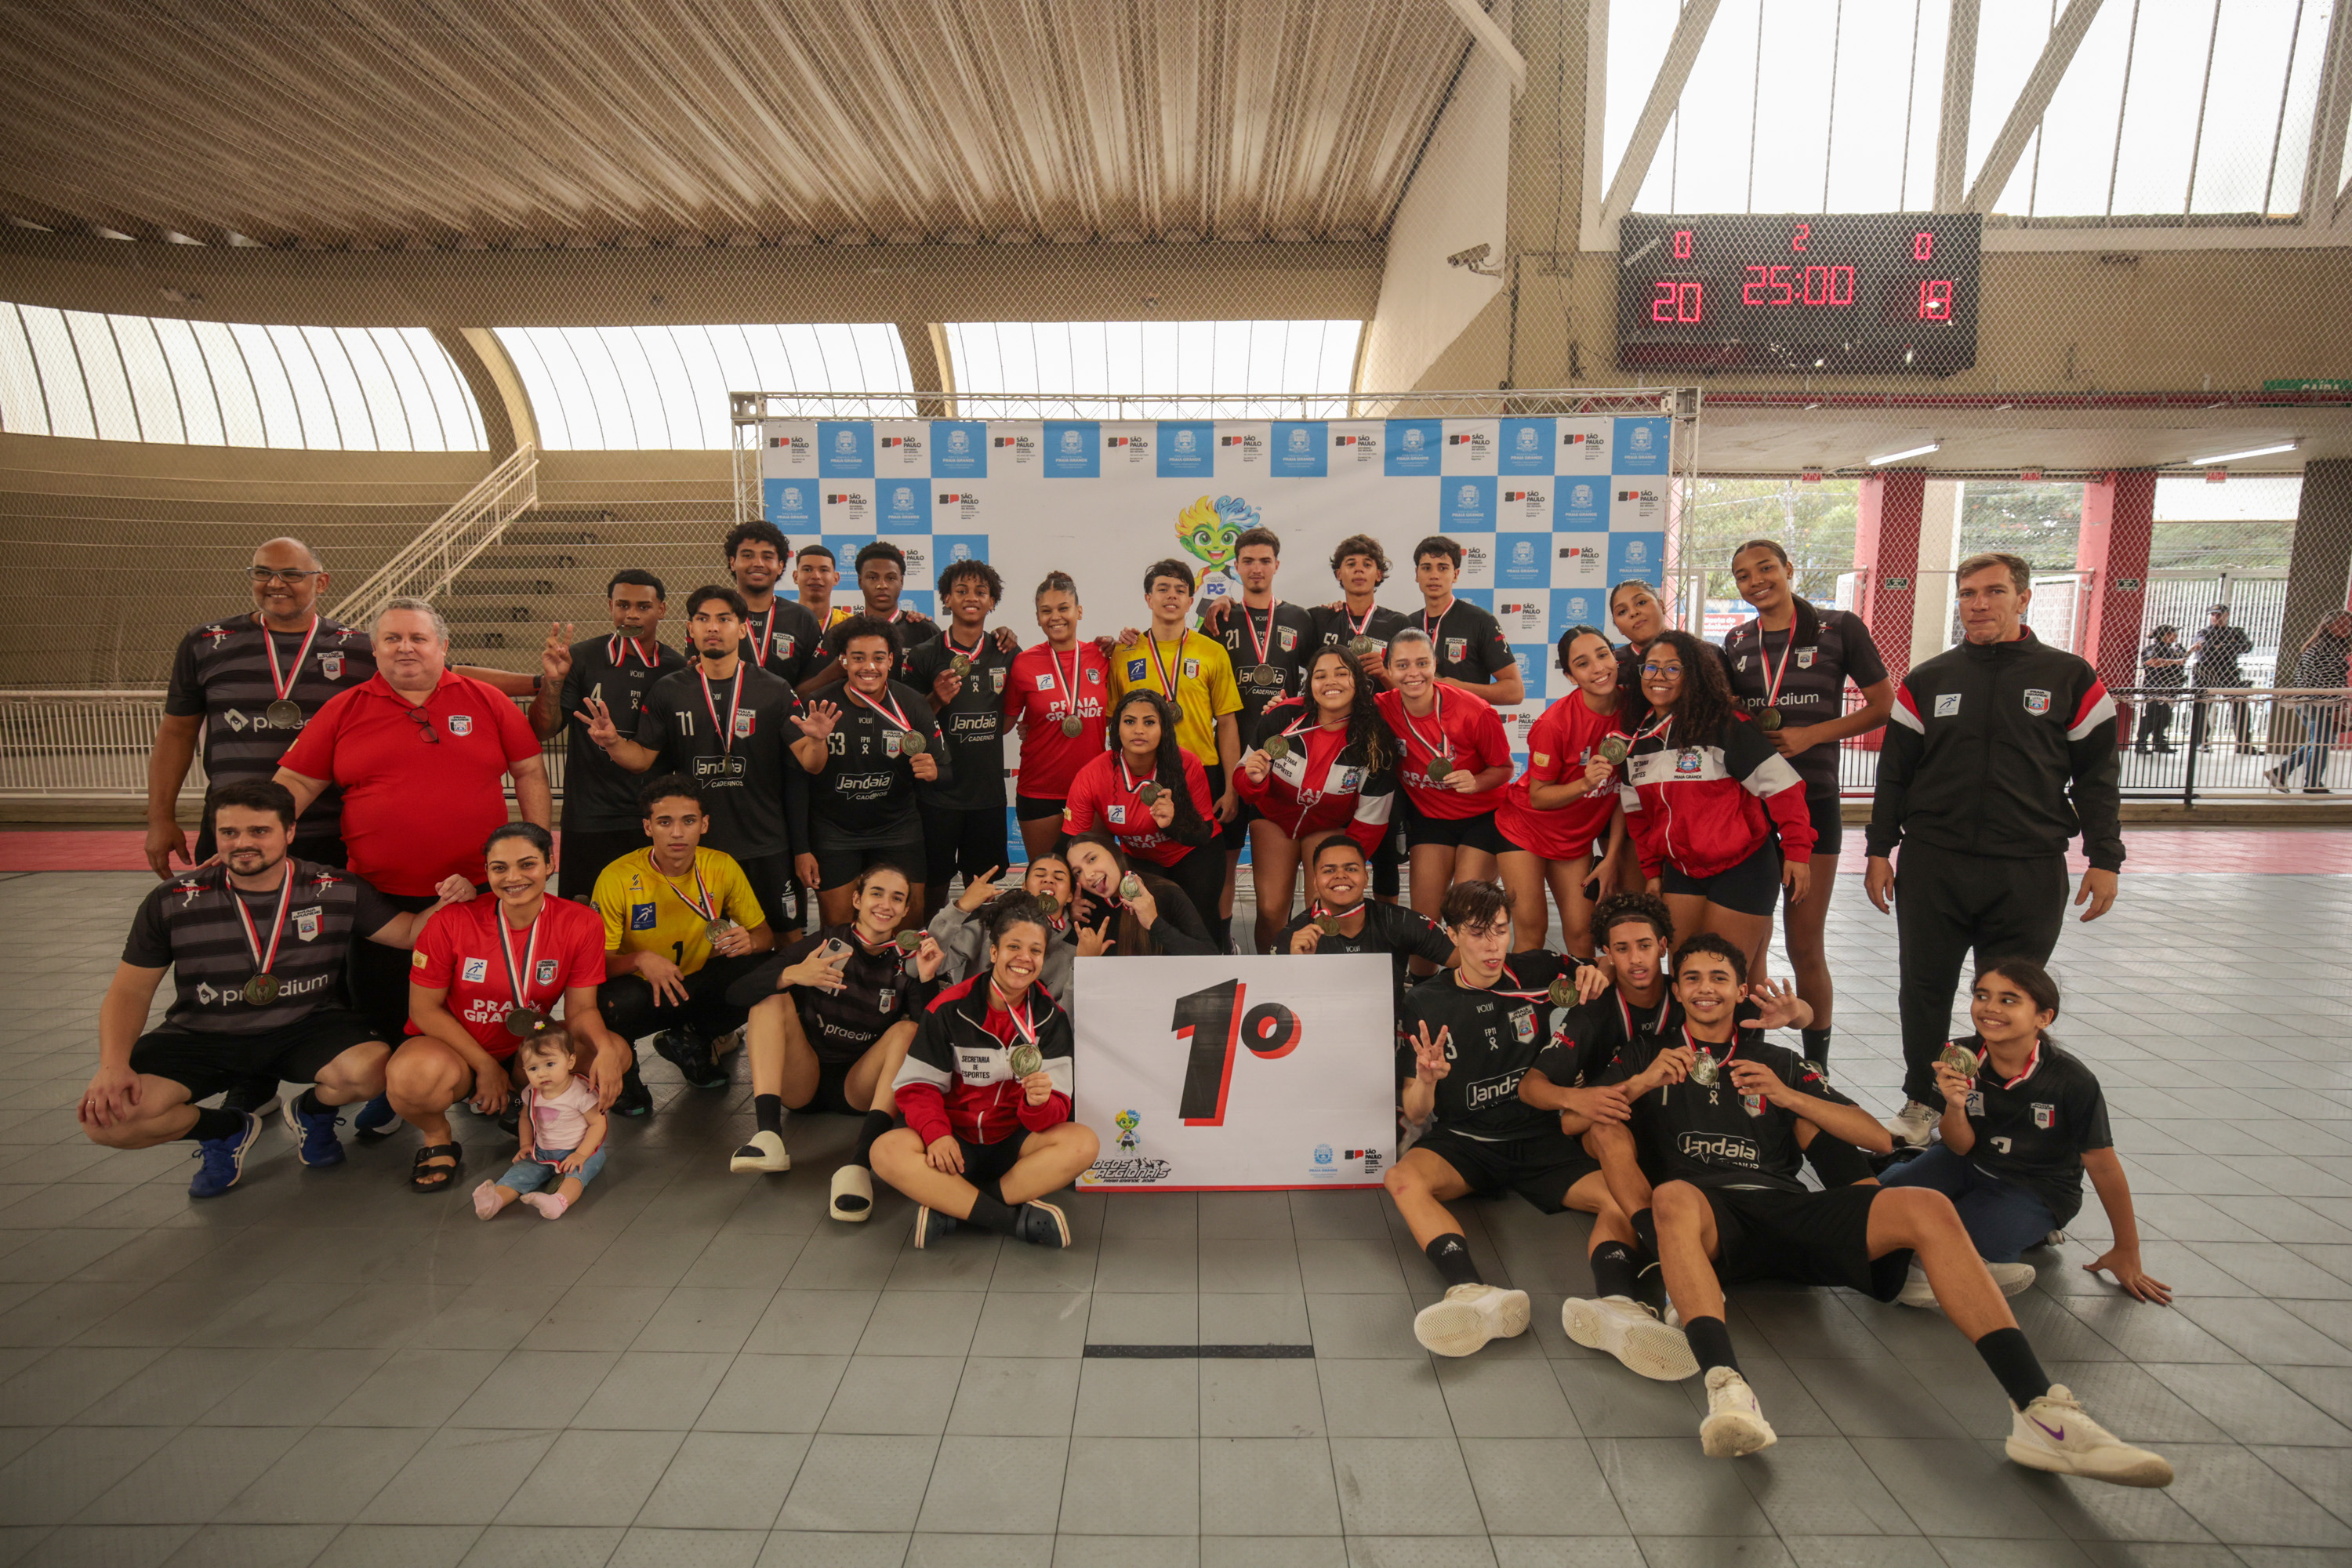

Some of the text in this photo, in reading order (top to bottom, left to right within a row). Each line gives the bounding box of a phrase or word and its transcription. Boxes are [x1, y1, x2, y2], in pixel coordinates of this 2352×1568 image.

[1675, 230, 1691, 259] 0
[1793, 224, 1809, 251] 2
[1915, 232, 1933, 260] 0
[1743, 265, 1854, 305] 25:00
[1653, 281, 1701, 322] 20
[1207, 583, 1226, 594] PG
[1225, 629, 1240, 651] 21
[1737, 655, 1748, 673] 4
[1237, 670, 1284, 685] Jaia
[590, 682, 602, 707] 4
[1045, 706, 1104, 722] GRNDE
[951, 714, 996, 732] Jandaia
[826, 731, 846, 756] 53
[968, 734, 995, 742] CADERNOS
[695, 759, 742, 776] Jandia
[837, 775, 891, 790] Jandaia
[1403, 770, 1436, 784] PRA
[855, 790, 888, 800] CADERNOS
[293, 910, 321, 920] GRANDE
[672, 941, 684, 966] 1
[223, 974, 328, 1007] prdium
[473, 998, 537, 1014] PRA
[1512, 1007, 1530, 1017] PRAIA
[1511, 1009, 1533, 1021] GRANDE
[823, 1024, 877, 1042] praedi
[1483, 1026, 1497, 1037] FP11
[961, 1054, 990, 1064] SECRETARIA
[961, 1070, 990, 1079] ESPORTES
[1469, 1072, 1525, 1107] Janda
[1091, 1160, 1134, 1169] OGOS
[1094, 1168, 1171, 1179] REGIONAIS
